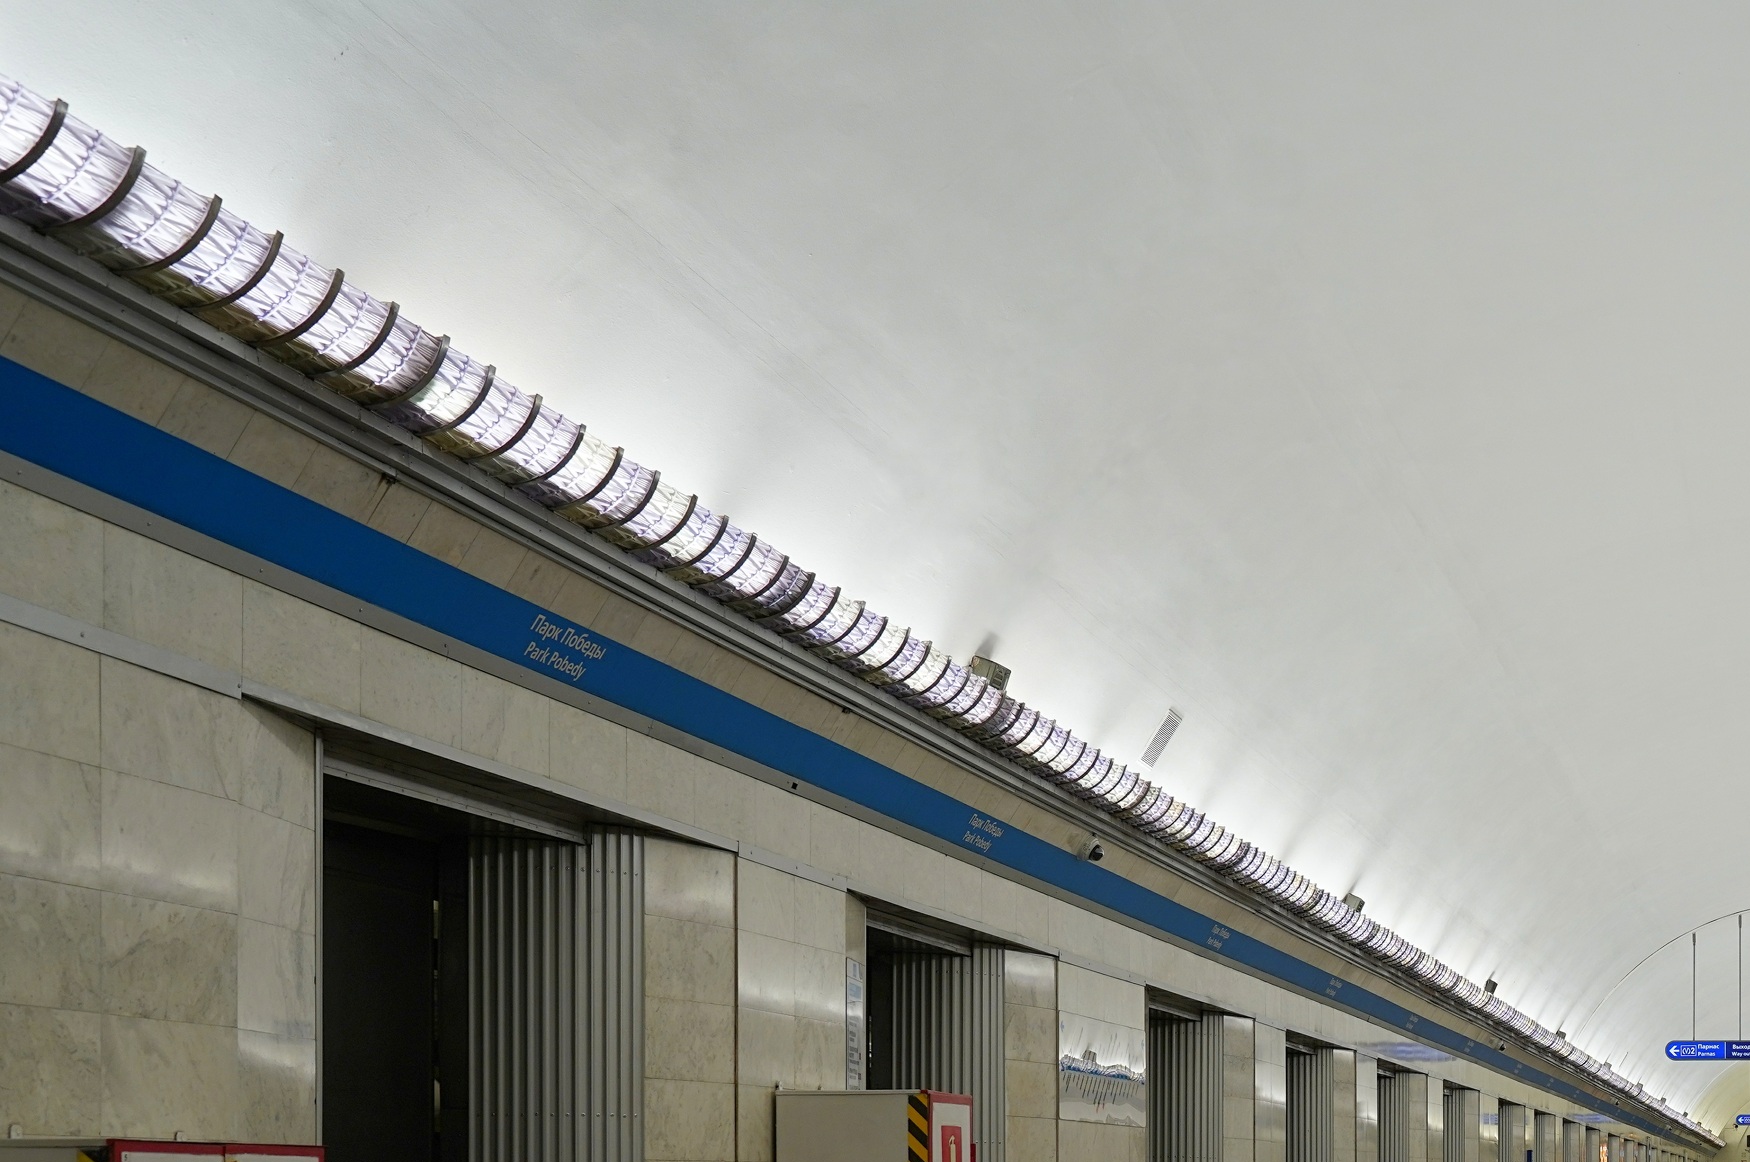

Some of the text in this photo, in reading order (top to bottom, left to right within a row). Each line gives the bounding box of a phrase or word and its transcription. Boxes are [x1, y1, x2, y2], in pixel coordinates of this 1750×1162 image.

[530, 614, 606, 660] Парк Победы
[524, 641, 587, 681] Park Pobedy
[1697, 1043, 1720, 1051] Парнас
